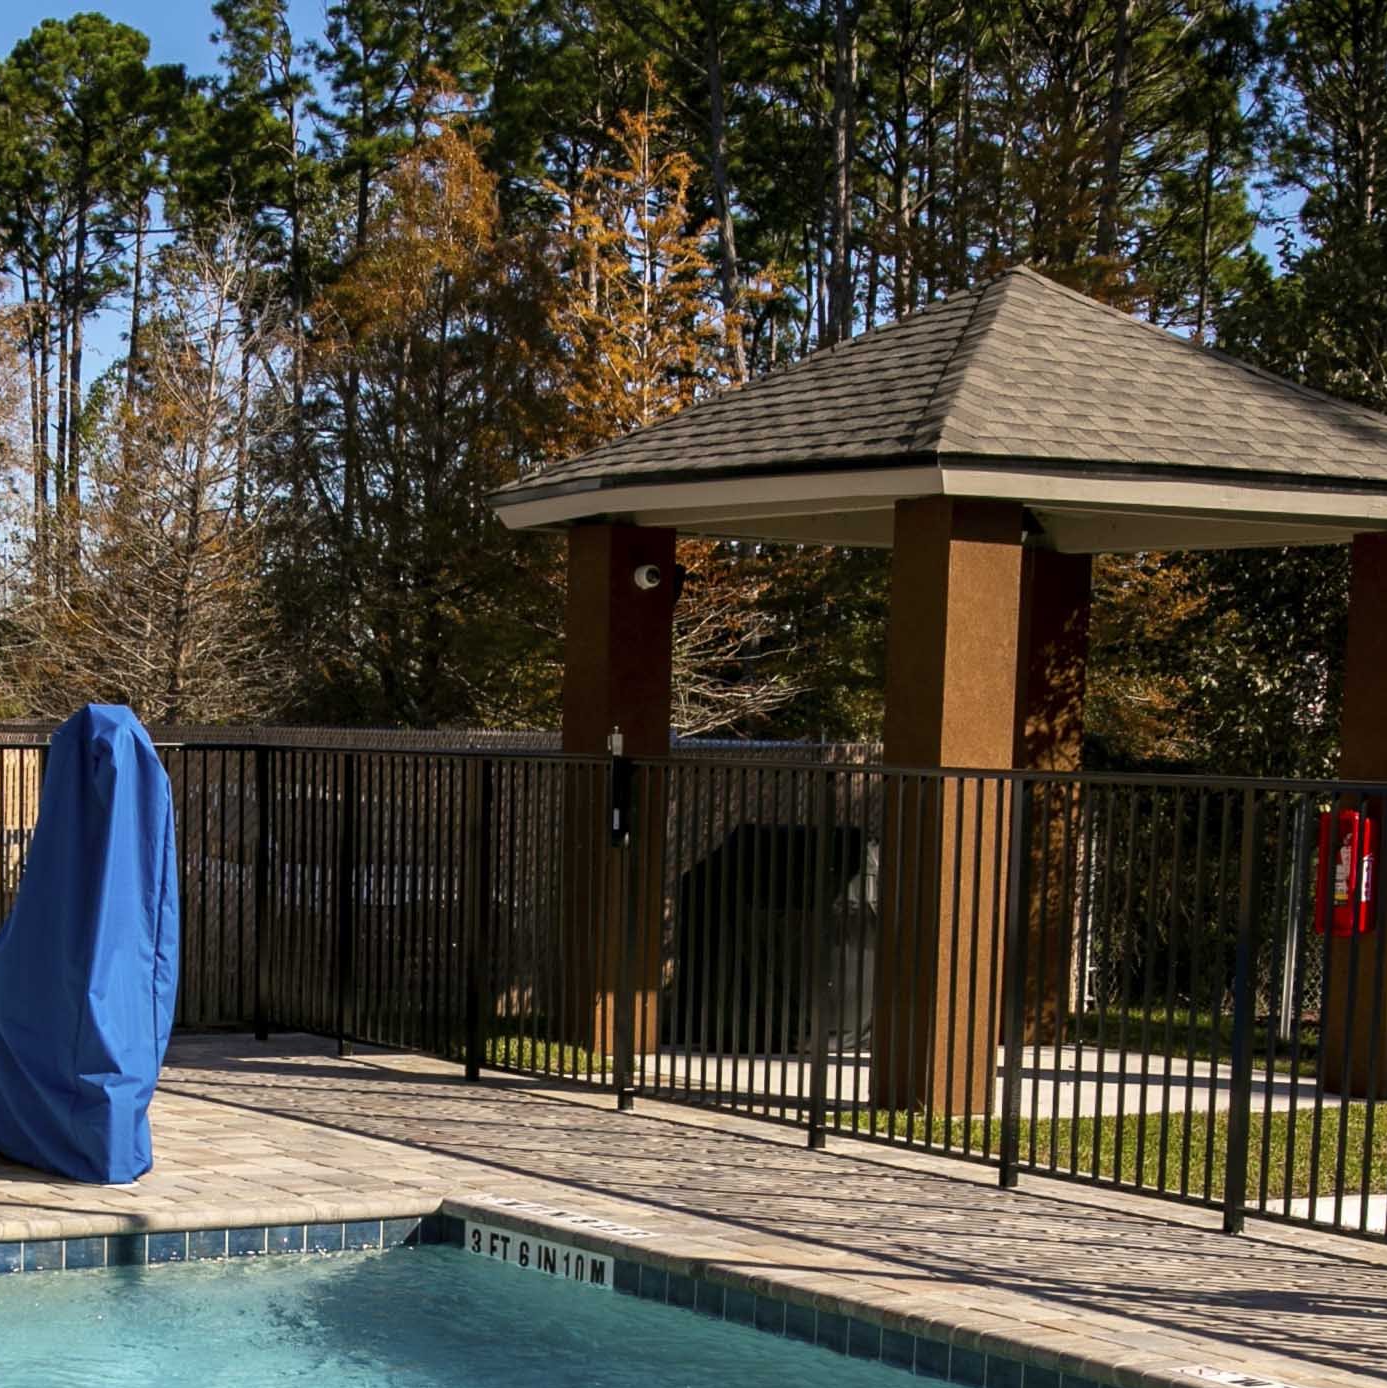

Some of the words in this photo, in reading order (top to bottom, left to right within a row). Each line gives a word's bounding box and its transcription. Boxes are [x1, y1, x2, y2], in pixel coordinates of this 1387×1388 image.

[471, 1228, 482, 1254] 3
[489, 1231, 510, 1261] FT
[519, 1241, 530, 1267] 6
[537, 1245, 557, 1274] IN
[590, 1258, 605, 1285] M
